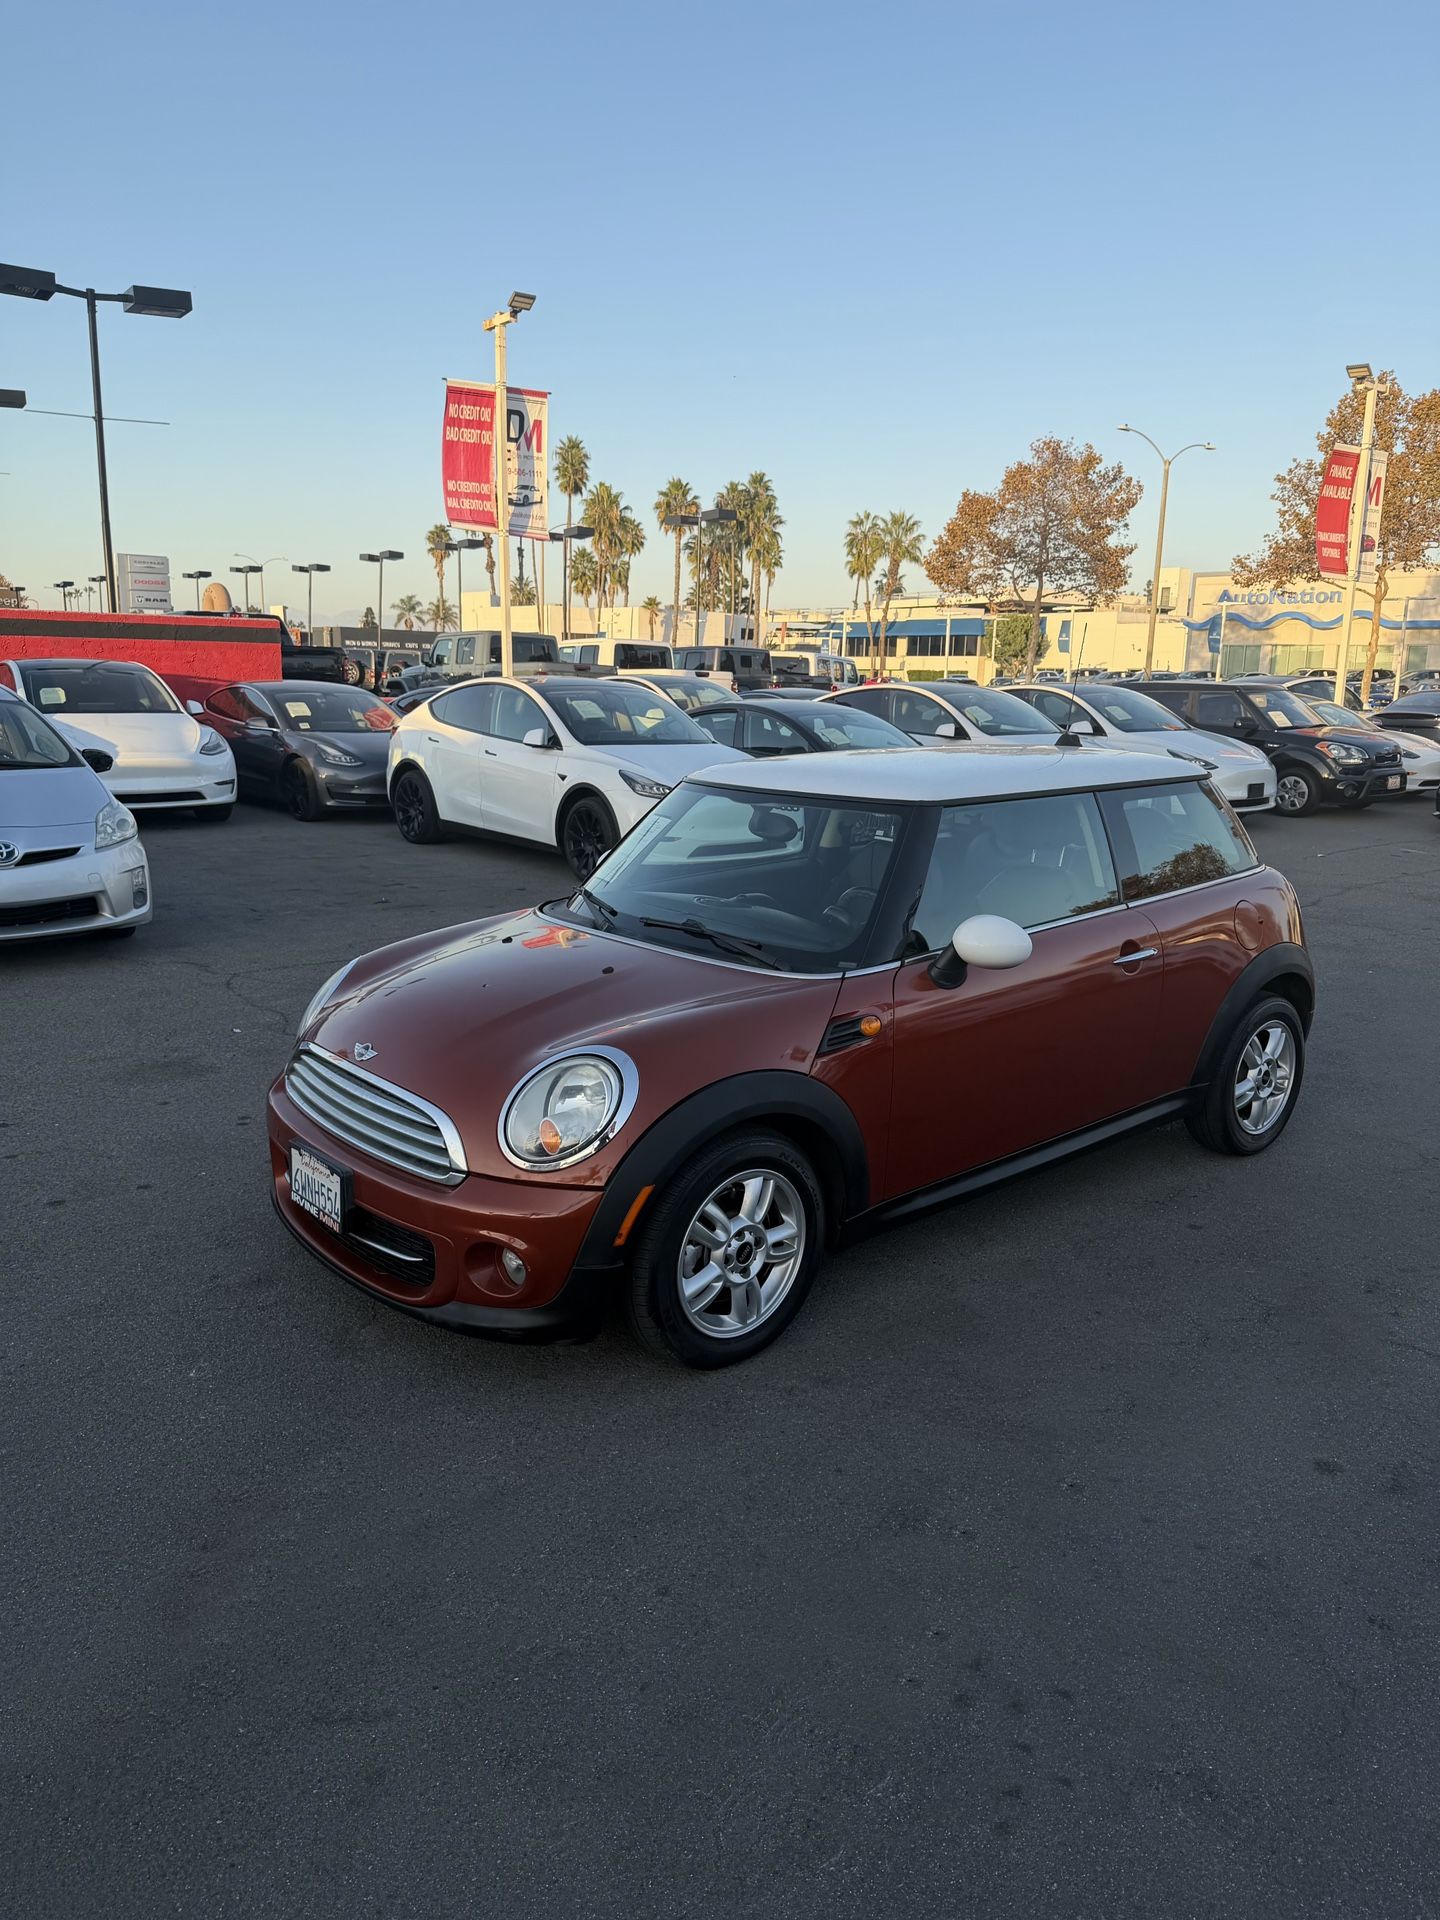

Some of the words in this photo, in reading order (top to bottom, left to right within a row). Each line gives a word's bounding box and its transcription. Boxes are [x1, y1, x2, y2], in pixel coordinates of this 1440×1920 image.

[449, 403, 458, 418] NO
[459, 405, 480, 421] CREDIT
[480, 407, 492, 422] OK!
[446, 426, 459, 441] BAD
[460, 428, 481, 443] CREDIT
[481, 430, 493, 445] OK!
[1329, 464, 1353, 480] FINANCE
[447, 480, 457, 491] NO
[1321, 484, 1352, 500] AVAILABLE
[447, 497, 460, 509] MAL
[1218, 586, 1342, 605] AutoNation
[293, 1168, 340, 1220] 6WNH554
[292, 1191, 319, 1218] IRVINE
[319, 1210, 340, 1233] MINI
